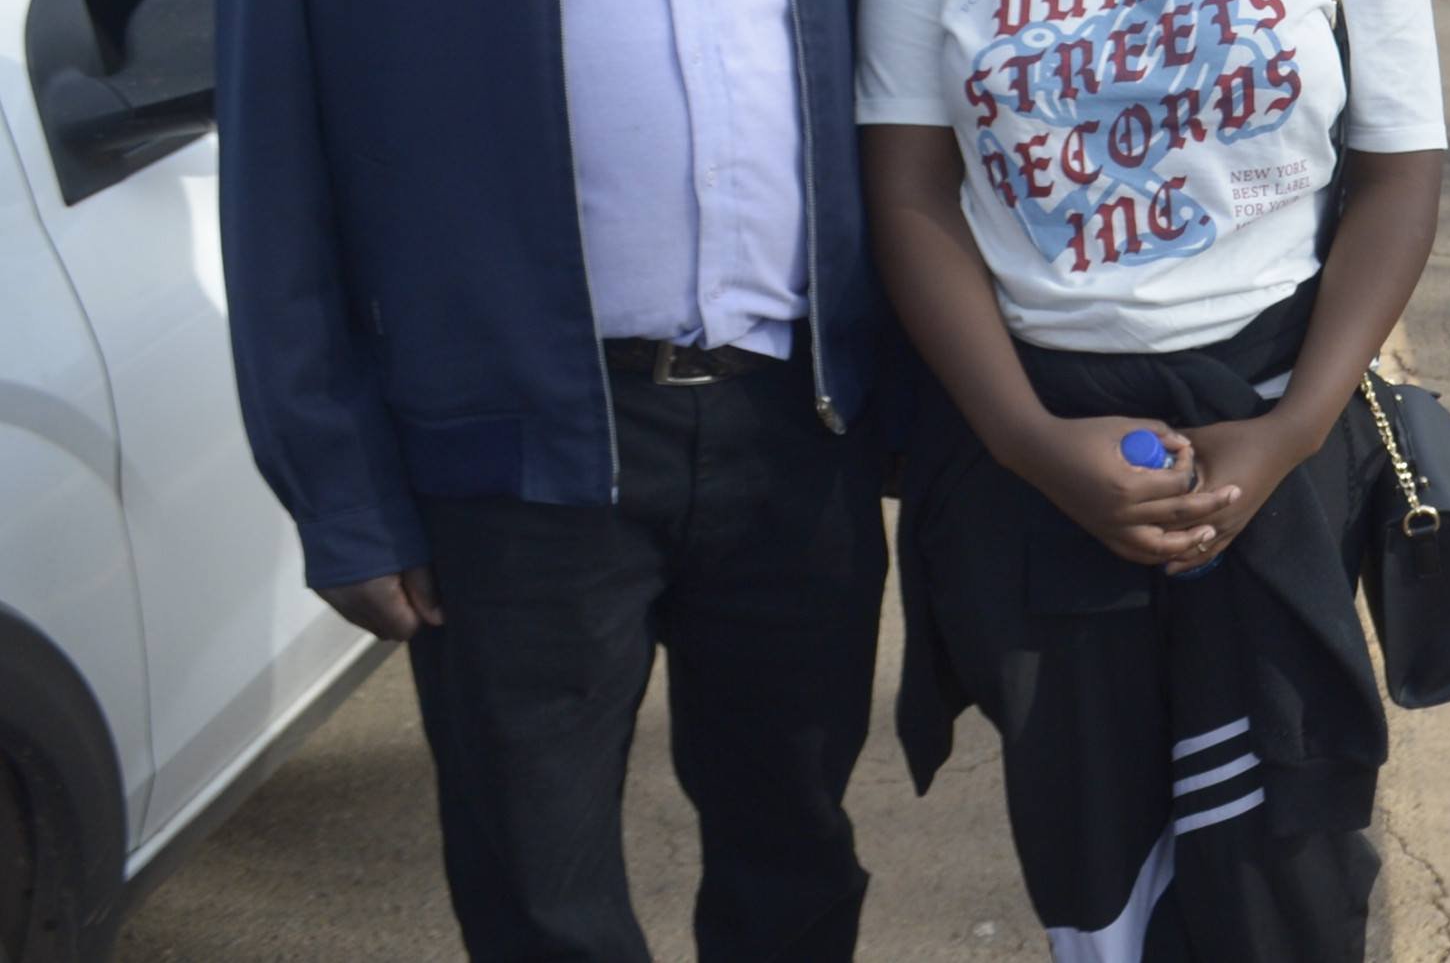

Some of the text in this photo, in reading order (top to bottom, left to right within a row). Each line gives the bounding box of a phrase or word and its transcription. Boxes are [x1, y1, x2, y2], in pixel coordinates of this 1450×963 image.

[981, 47, 1301, 209] RECORDS
[1230, 159, 1308, 184] NEW YORK
[1232, 184, 1269, 200] BEST
[1234, 203, 1264, 218] FOR
